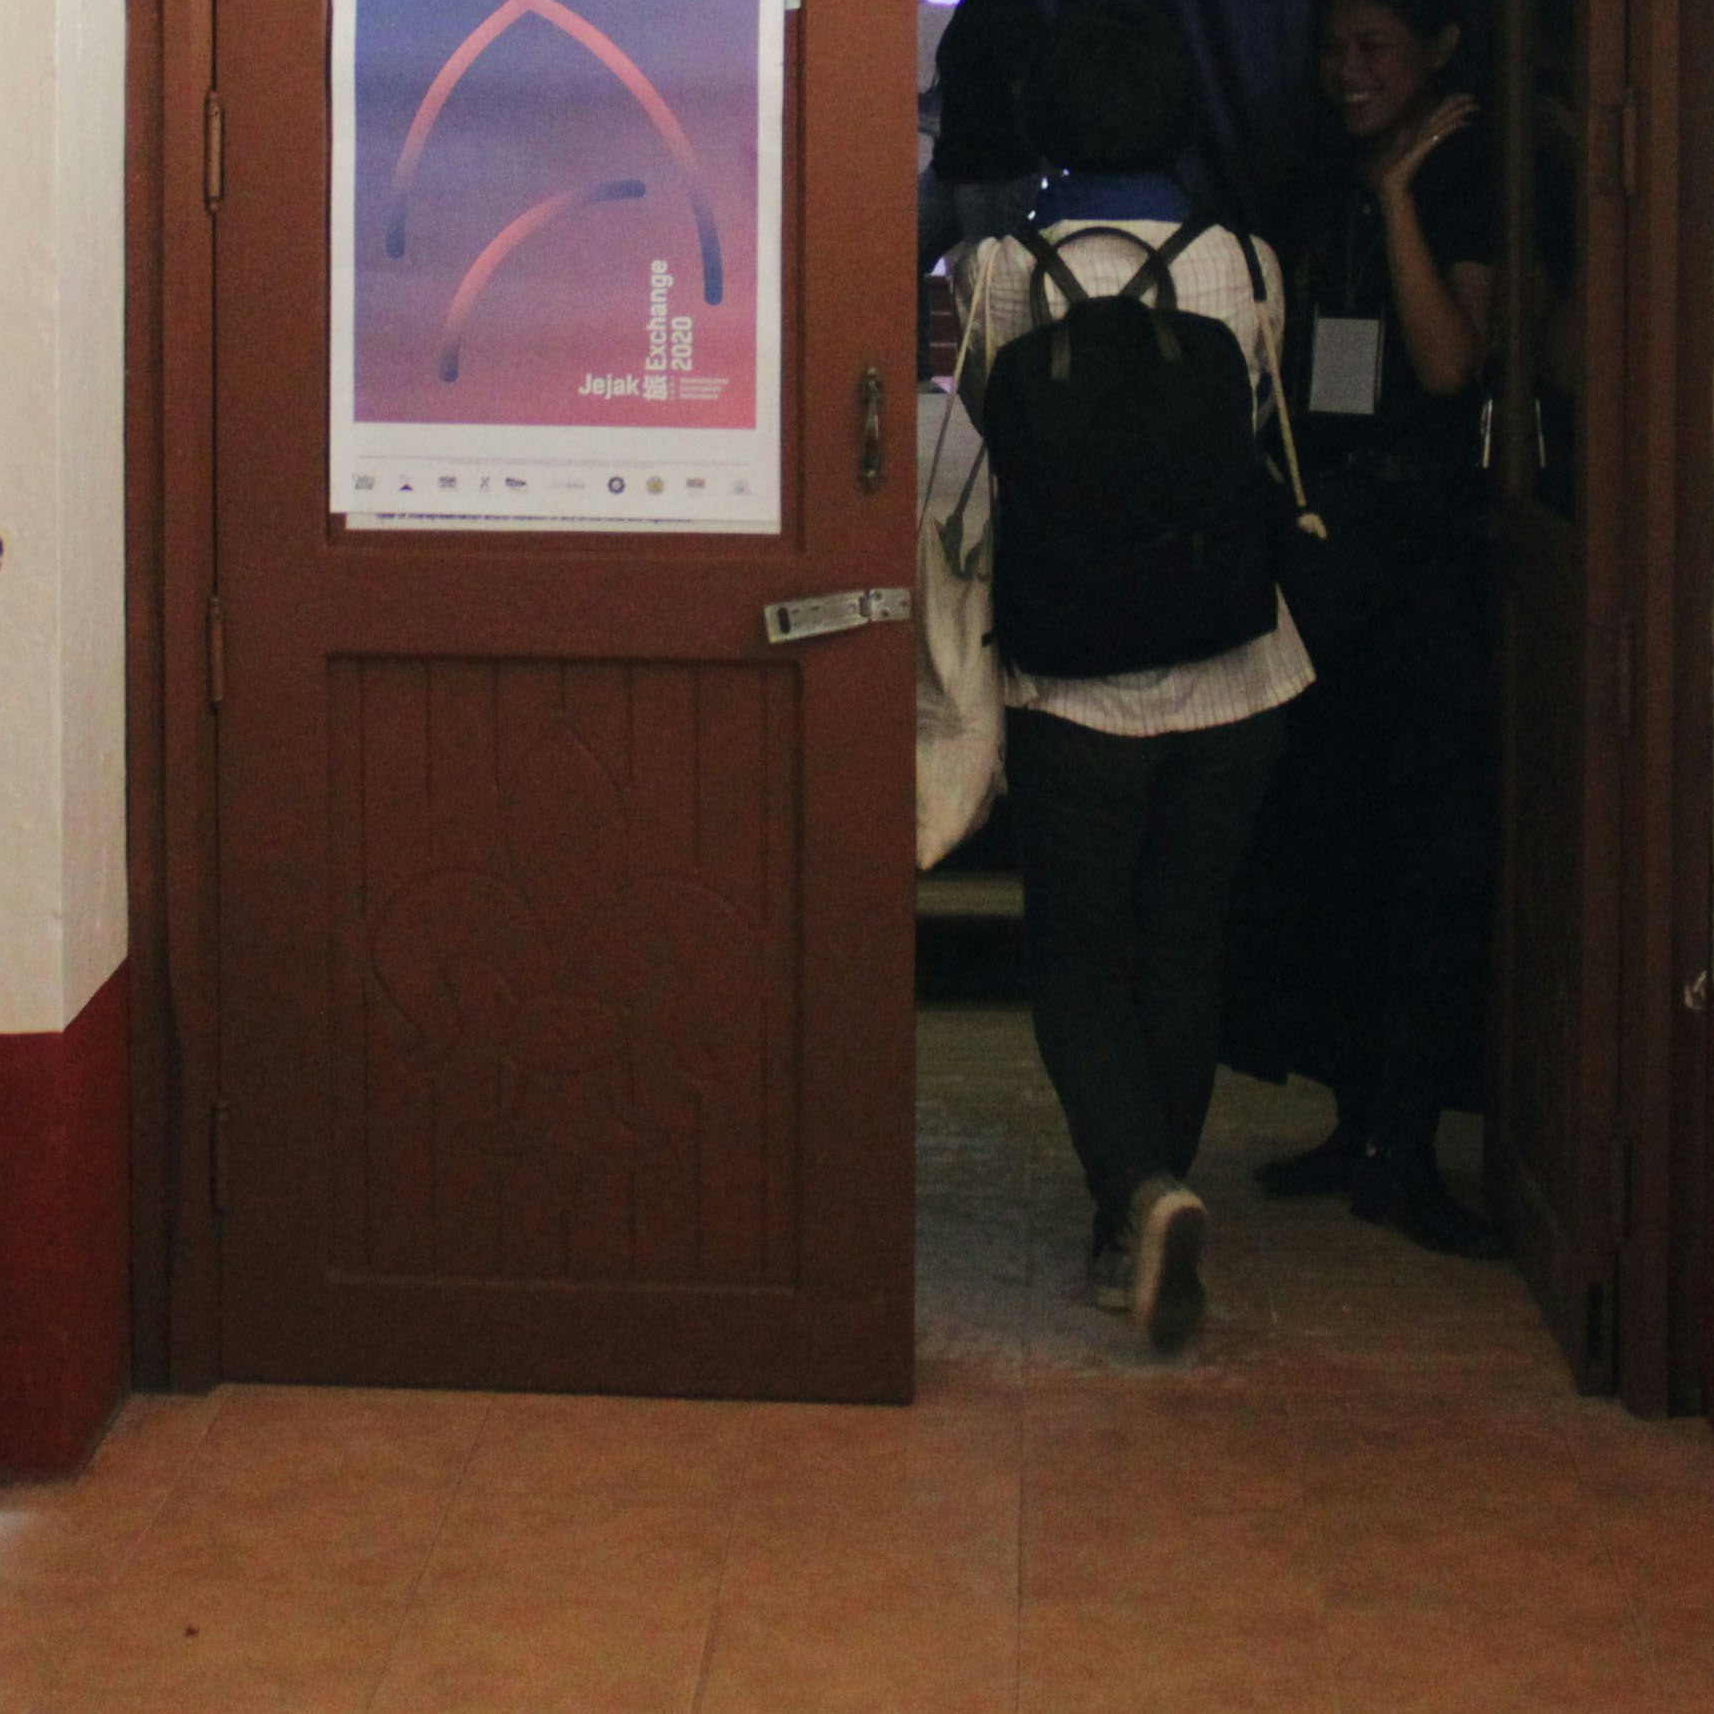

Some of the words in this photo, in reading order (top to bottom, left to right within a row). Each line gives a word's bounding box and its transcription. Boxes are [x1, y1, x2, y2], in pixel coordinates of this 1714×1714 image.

[646, 260, 674, 371] Exchange
[671, 316, 693, 371] 2020
[578, 373, 640, 400] Jejak
